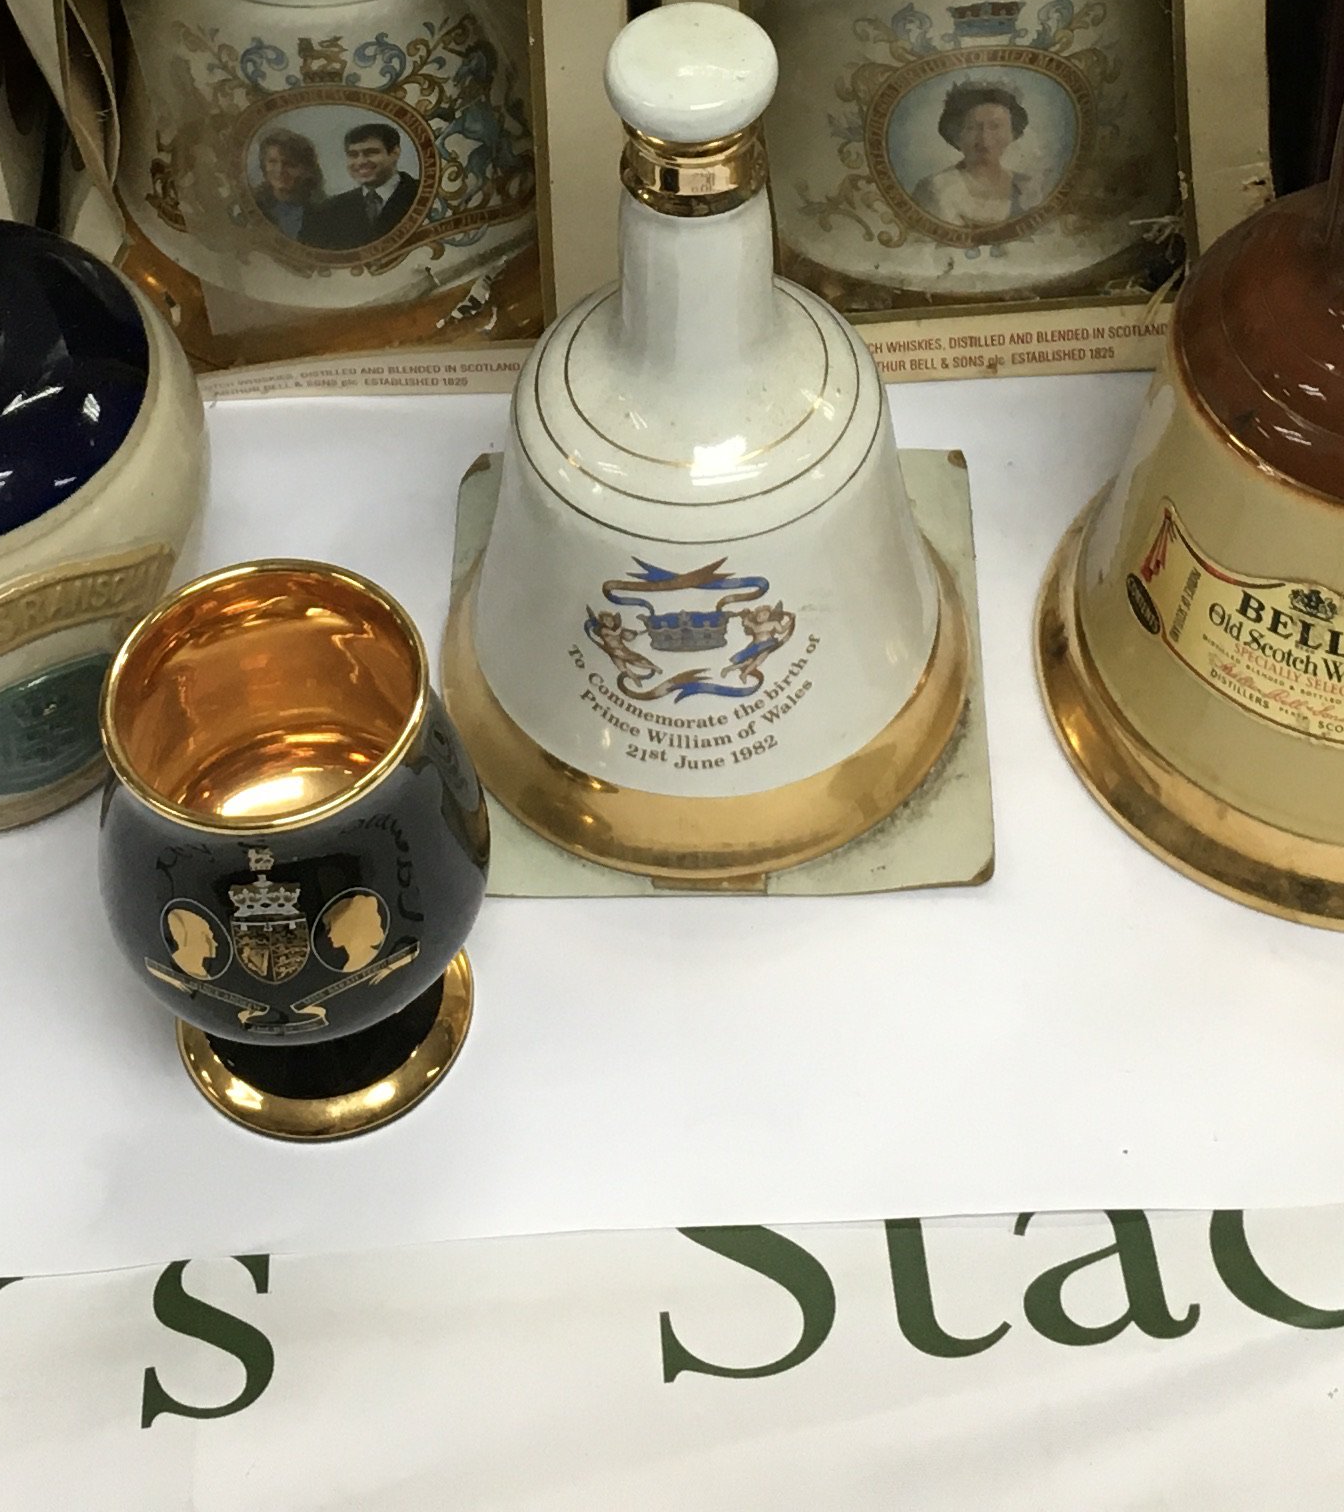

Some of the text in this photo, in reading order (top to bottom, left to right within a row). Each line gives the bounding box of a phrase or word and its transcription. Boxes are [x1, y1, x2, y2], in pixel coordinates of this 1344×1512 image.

[886, 338, 946, 354] WHISKIES,
[949, 334, 1005, 350] DISTILLED
[1008, 332, 1032, 346] AND
[1036, 328, 1090, 344] BLENDED
[1092, 326, 1105, 339] IN
[1107, 322, 1169, 339] SCOTLAND
[300, 367, 356, 379] DISTILLED
[361, 366, 384, 375] AND
[388, 363, 441, 374] BLENDED
[444, 363, 456, 373] IN
[460, 361, 520, 373] SCOTLAND
[910, 358, 937, 371] BELL
[940, 357, 949, 369] &
[953, 355, 985, 369] SONS
[1011, 348, 1085, 365] ESTABLISHED
[1089, 346, 1114, 360] 1825
[364, 376, 439, 387] ESTABLISHED
[442, 376, 468, 386] 1825
[1209, 602, 1243, 641] Old
[1244, 628, 1318, 676] Scotch
[568, 634, 821, 729] To Commemorate the birth of
[1234, 643, 1302, 683] SPECIALLY
[1210, 668, 1270, 710] DISTILLERS
[1246, 664, 1285, 686] BLENDED
[1300, 687, 1342, 705] BOTTLED
[580, 679, 814, 749] Prince William of Wales
[626, 734, 779, 770] 21st June 1982
